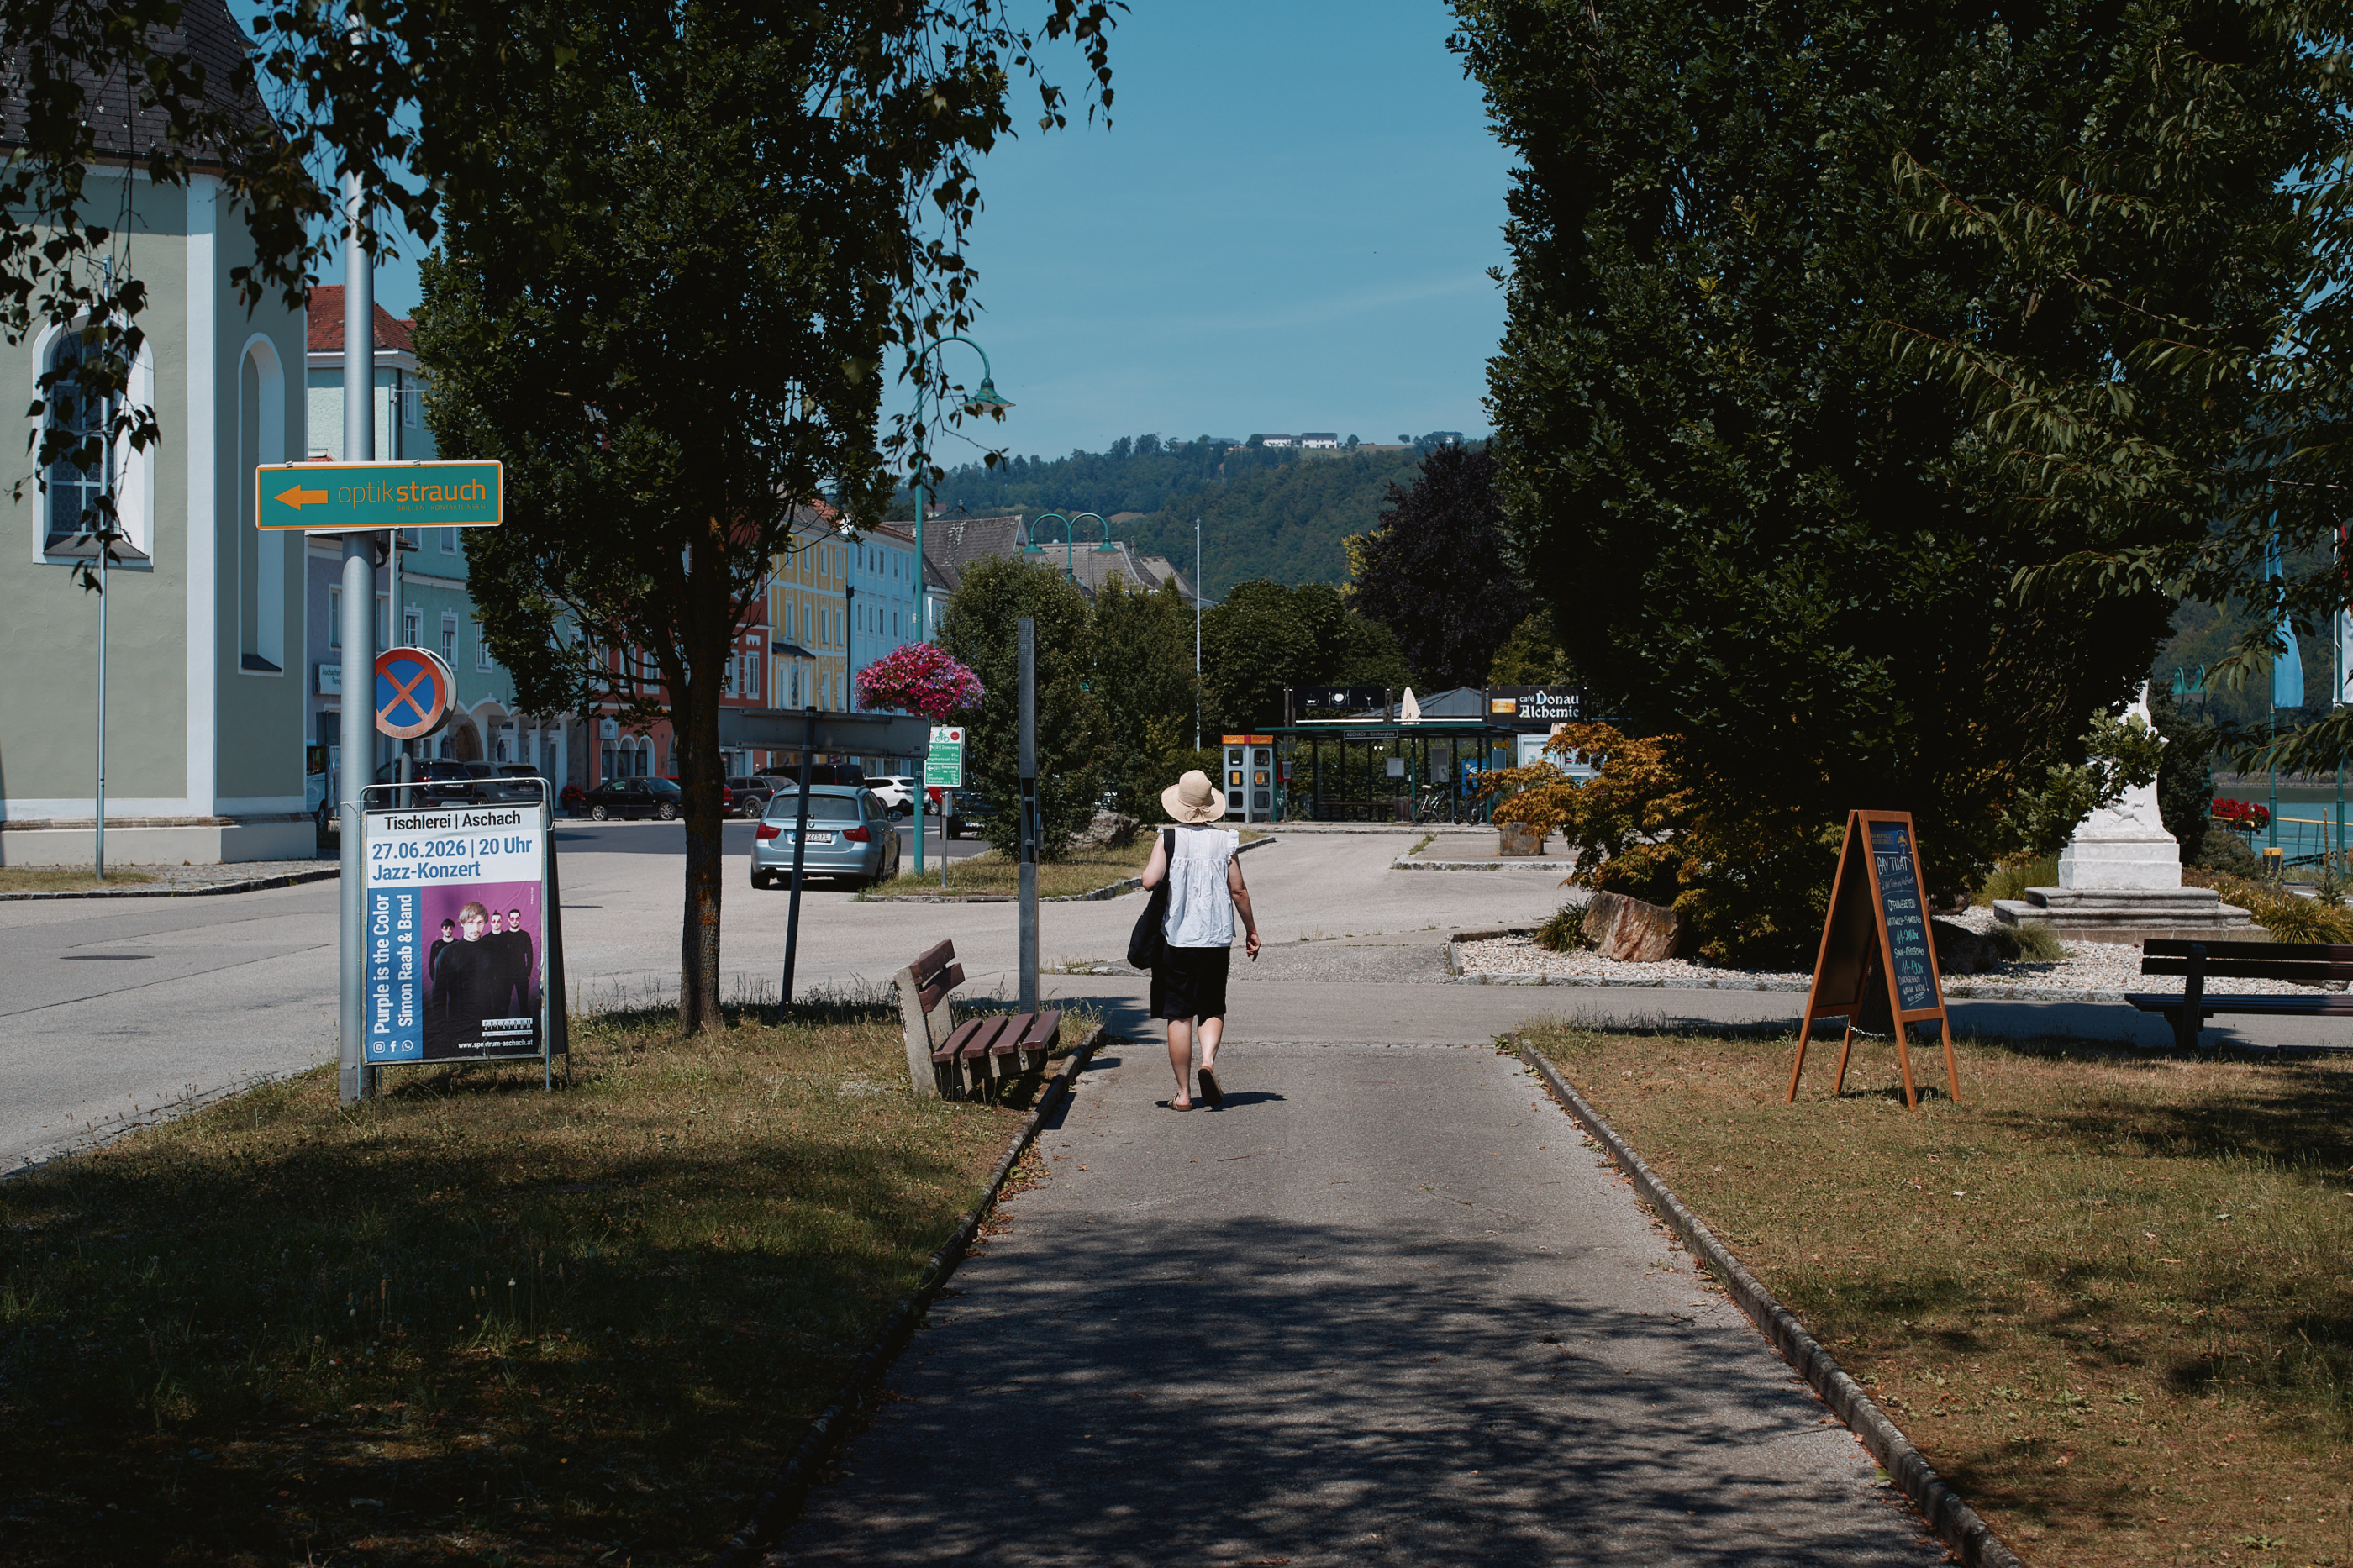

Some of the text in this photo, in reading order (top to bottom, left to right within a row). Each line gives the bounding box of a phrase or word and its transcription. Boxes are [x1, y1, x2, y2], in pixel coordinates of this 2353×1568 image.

[1519, 690, 1580, 706] café Donau
[1519, 704, 1580, 718] Alchemie
[385, 724, 421, 737] ENDE
[384, 813, 451, 830] Tischlerei
[462, 810, 521, 827] Aschach
[372, 839, 466, 860] 27.06.2026
[479, 838, 499, 855] 20
[503, 836, 533, 854] Uhr
[372, 860, 481, 881] Jazz-Konzert
[372, 894, 394, 1034] Purple is the Color
[397, 894, 413, 1027] Simon Raab & Band
